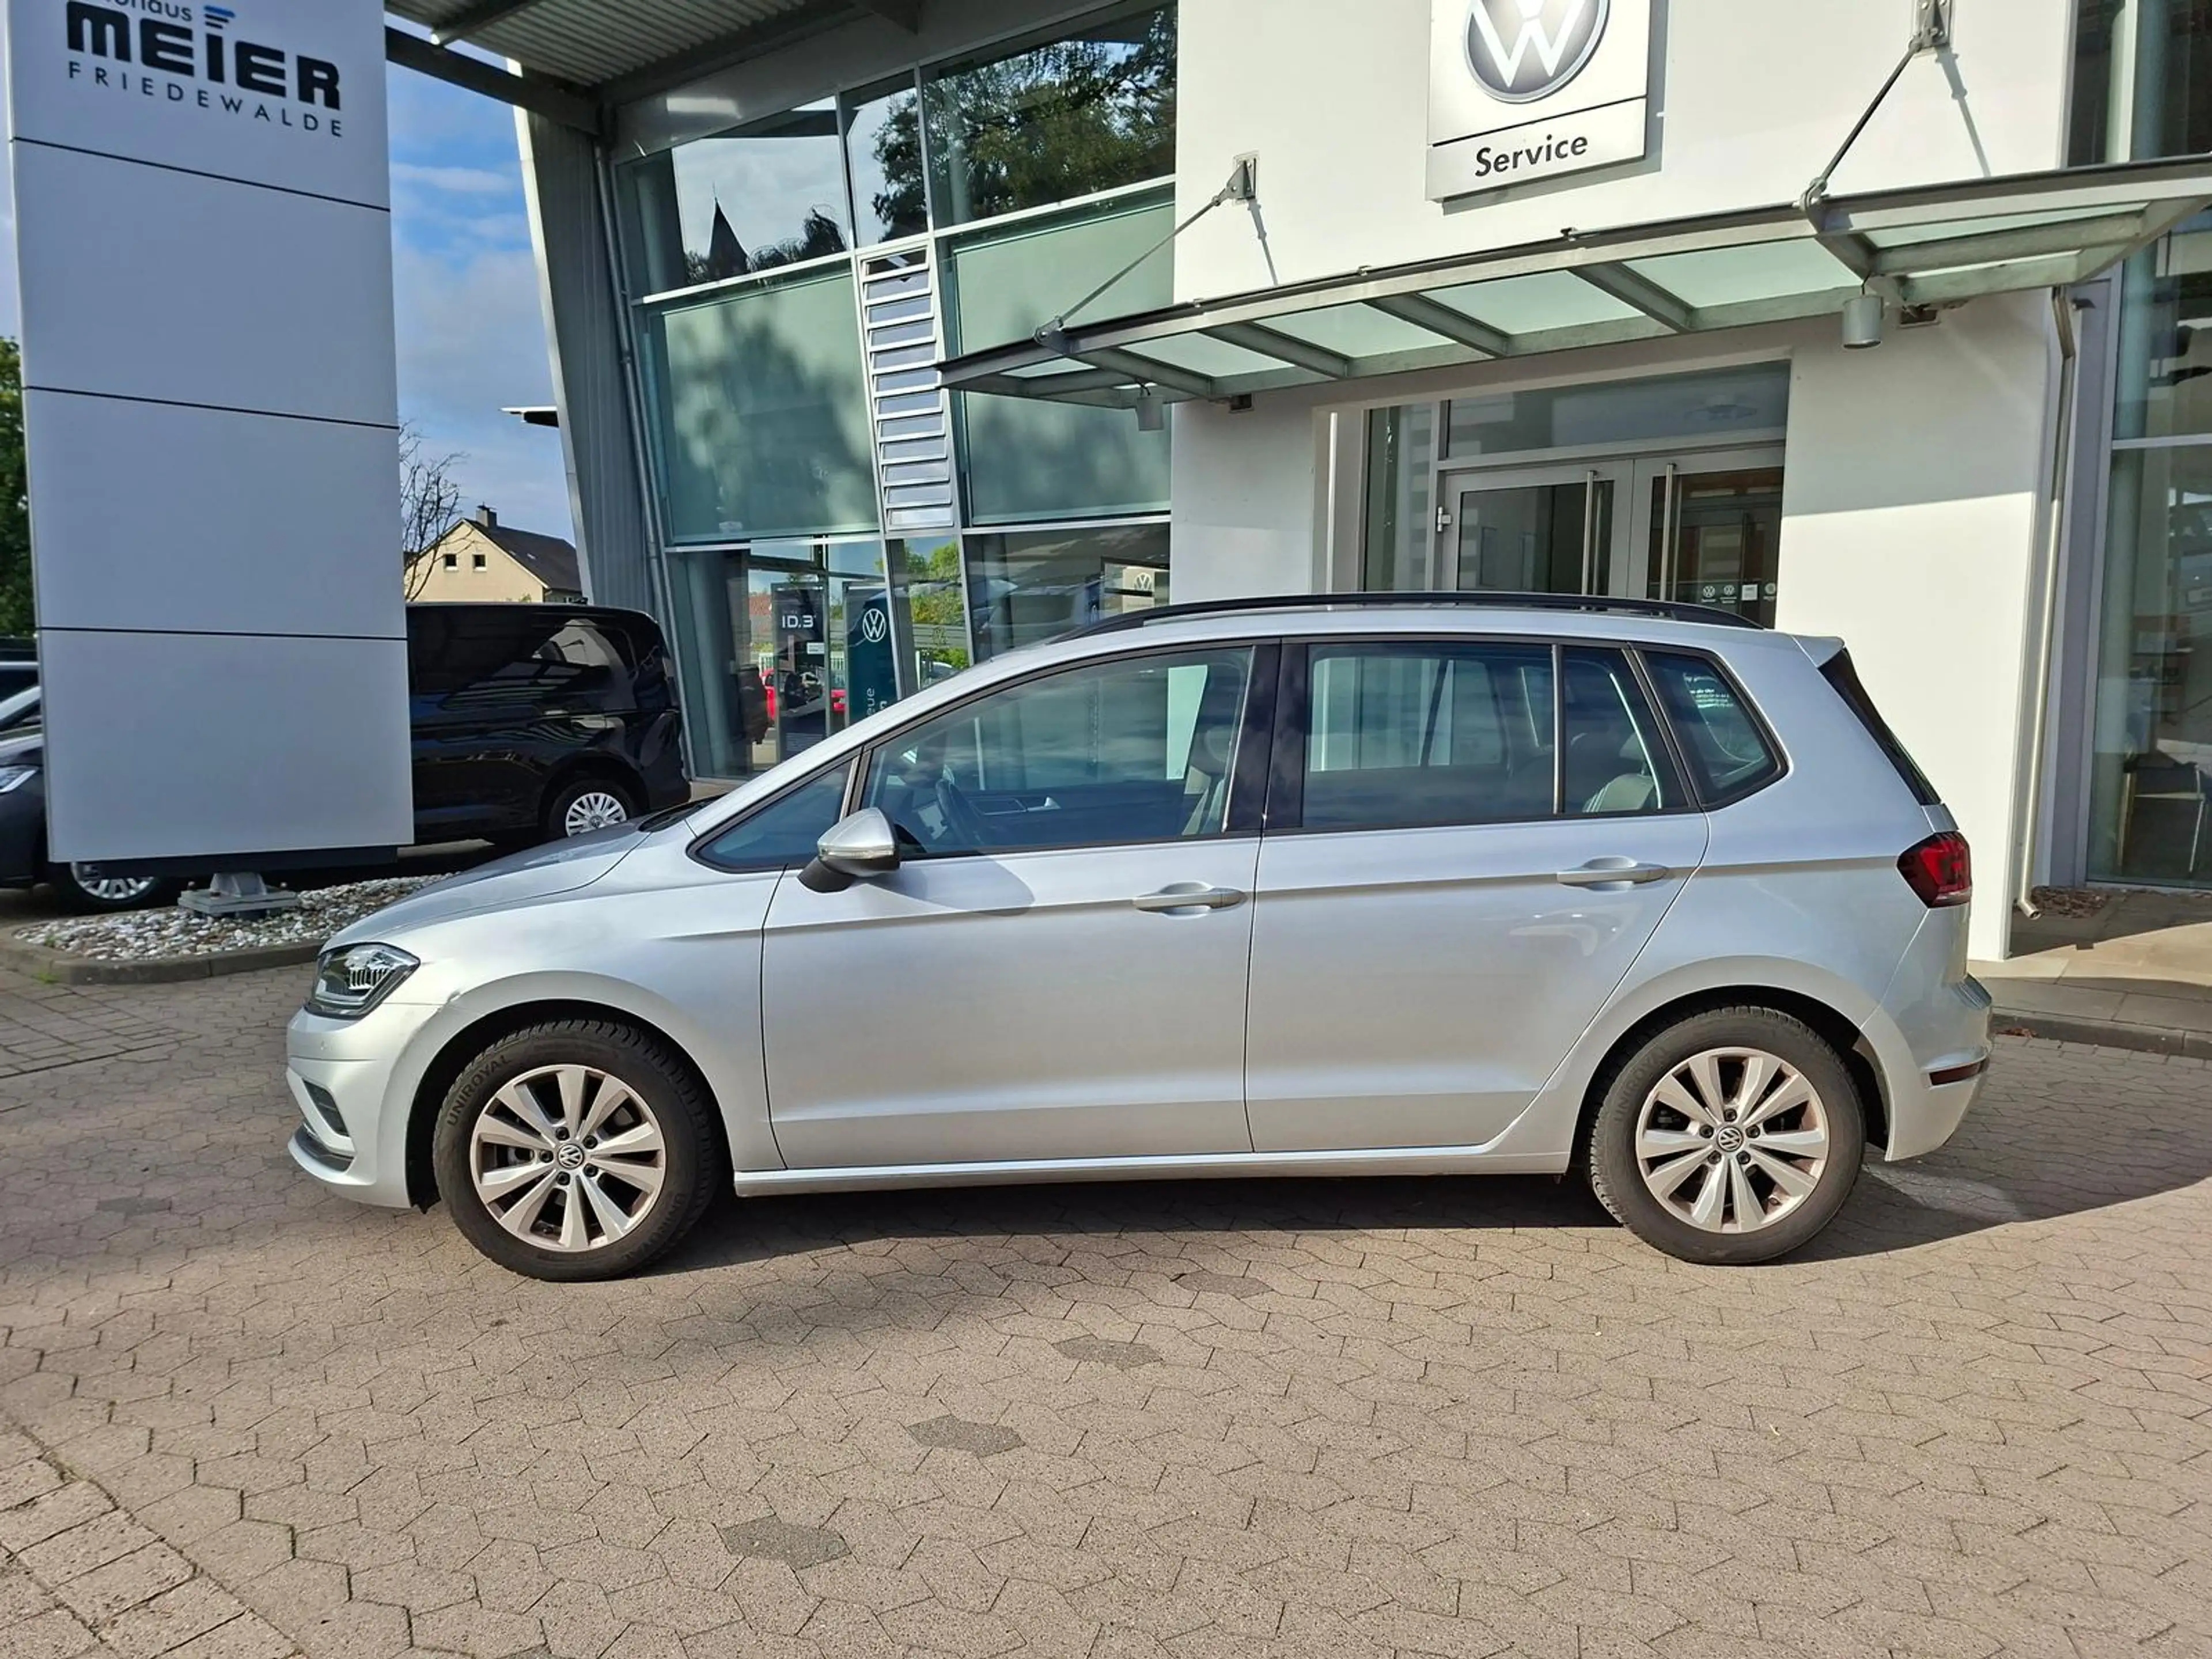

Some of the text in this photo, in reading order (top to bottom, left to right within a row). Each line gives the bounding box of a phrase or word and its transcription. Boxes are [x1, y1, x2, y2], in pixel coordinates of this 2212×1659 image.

[69, 61, 342, 137] FRIEDEWALDE
[1475, 134, 1588, 177] Service
[782, 615, 814, 628] ID.3
[447, 1055, 513, 1126] UNIROYAL
